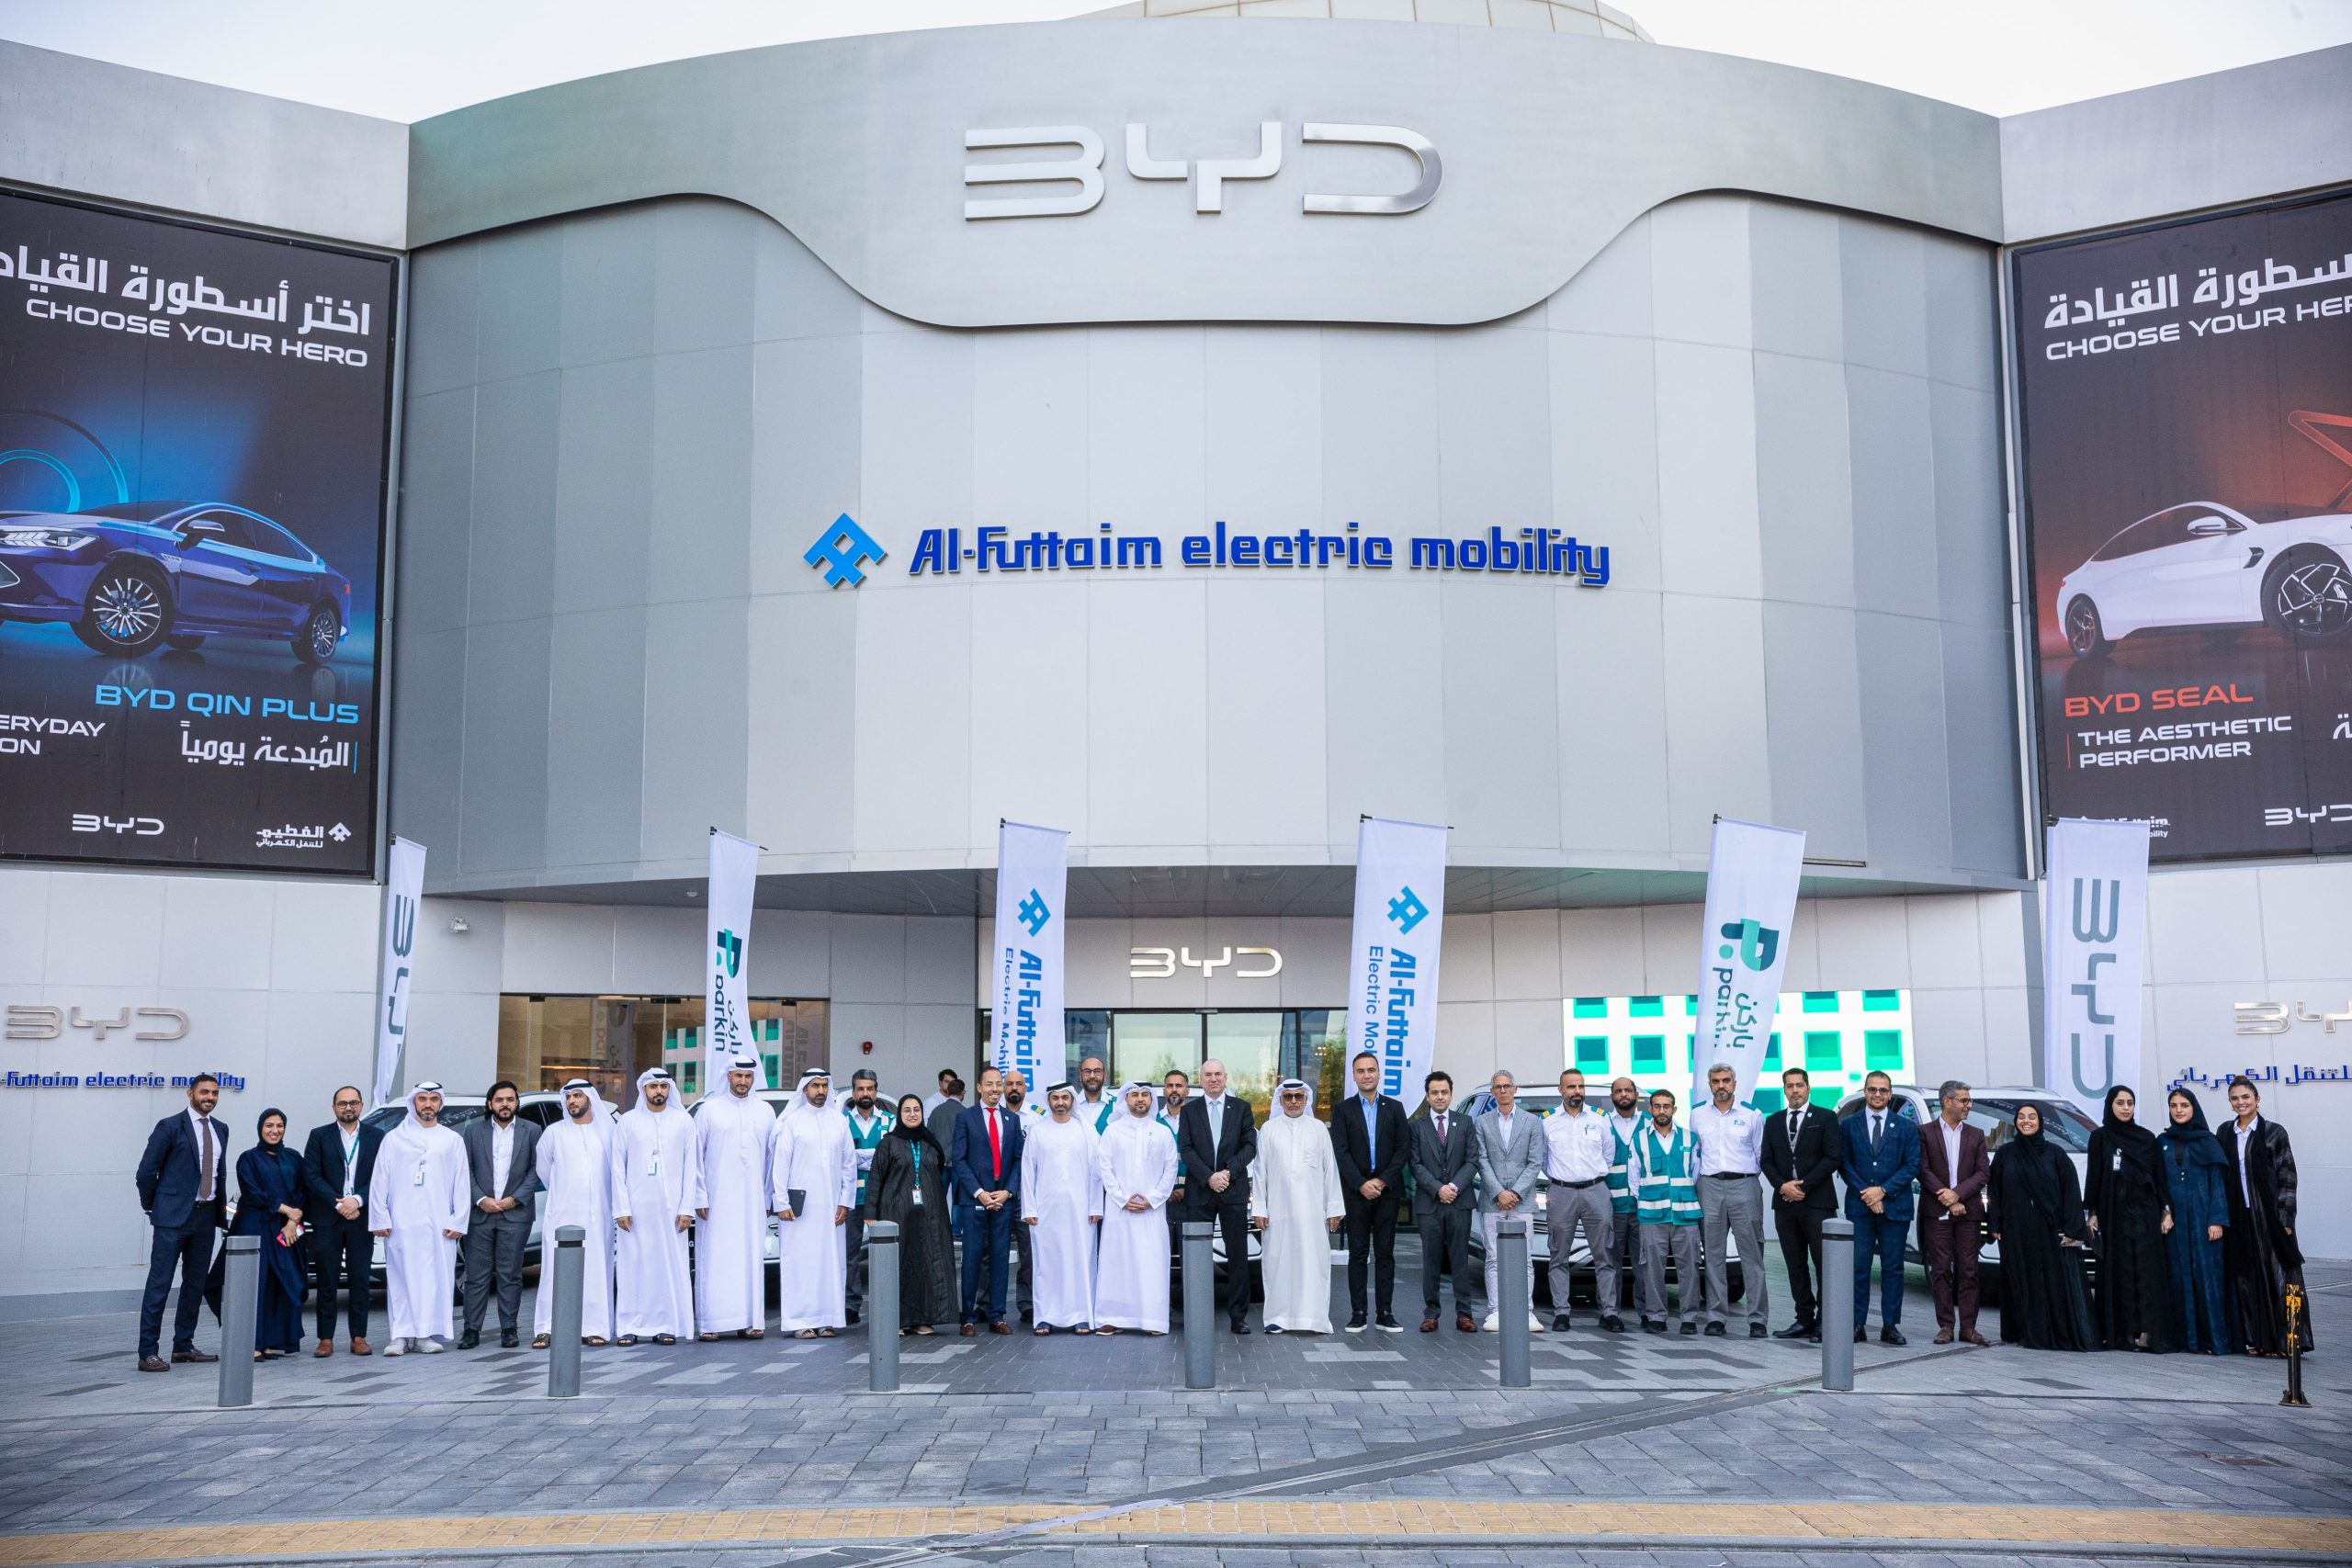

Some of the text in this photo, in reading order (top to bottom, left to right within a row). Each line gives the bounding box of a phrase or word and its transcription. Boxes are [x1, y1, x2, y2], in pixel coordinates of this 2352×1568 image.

[965, 121, 1444, 221] BYD
[121, 265, 289, 322] أسطورة
[298, 295, 370, 335] اختر
[2044, 274, 2179, 329] القيادة
[26, 298, 368, 367] CHOOSE YOUR HERO
[2046, 322, 2180, 361] CHOOSE
[2188, 306, 2287, 337] YOUR
[909, 520, 1610, 588] Al-Futtaim electric mobility
[95, 683, 359, 724] BYD QIN PLUS
[2064, 683, 2254, 717] BYD SEAL
[2077, 716, 2292, 747] THE AESTHETIC
[2079, 741, 2252, 769] PERFORMER
[72, 813, 164, 836] BYD
[388, 894, 415, 1057] BY
[1130, 946, 1283, 978] BYD
[1365, 945, 1384, 1015] Electric
[2071, 877, 2120, 1100] BYD
[6, 1004, 191, 1040] BYD
[1383, 947, 1417, 1097] Al-Futtaim
[1712, 966, 1733, 1048] parki
[85, 1070, 165, 1088] electric
